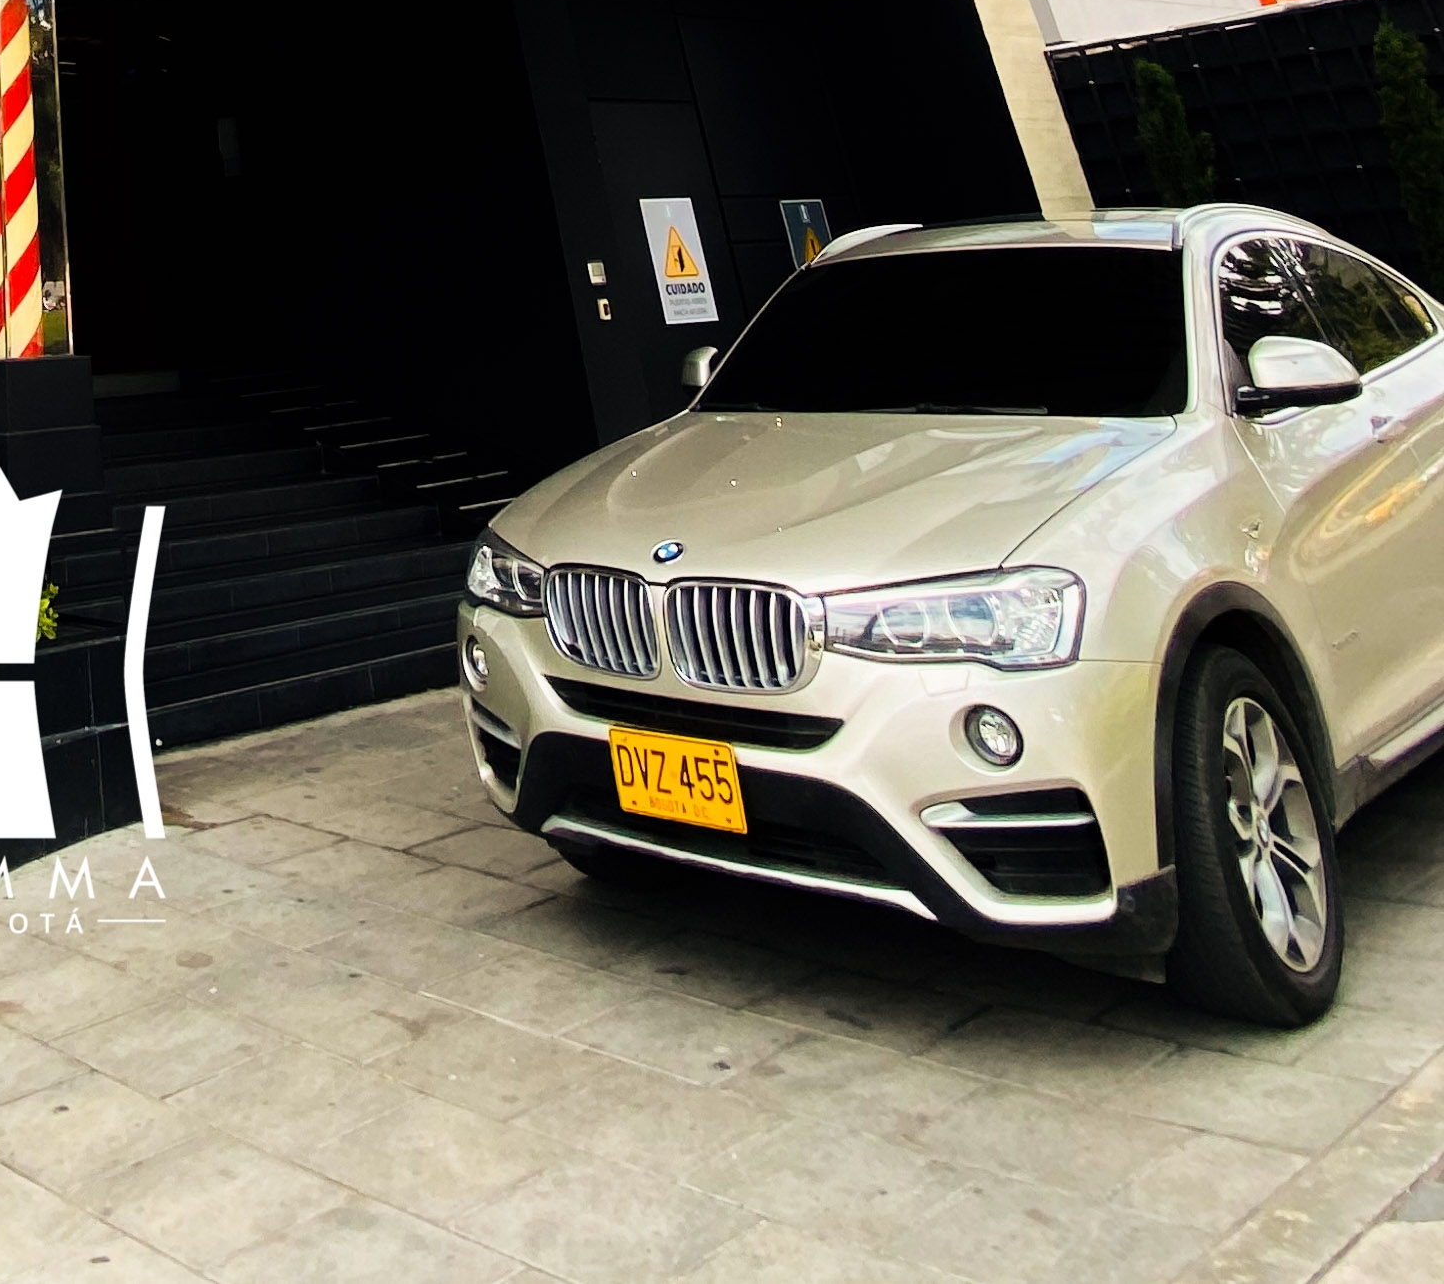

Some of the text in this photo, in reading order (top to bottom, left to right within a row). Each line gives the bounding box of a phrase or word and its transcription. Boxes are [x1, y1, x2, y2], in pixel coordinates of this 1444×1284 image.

[665, 281, 706, 296] CUIDADO
[616, 743, 734, 805] DVZ 455
